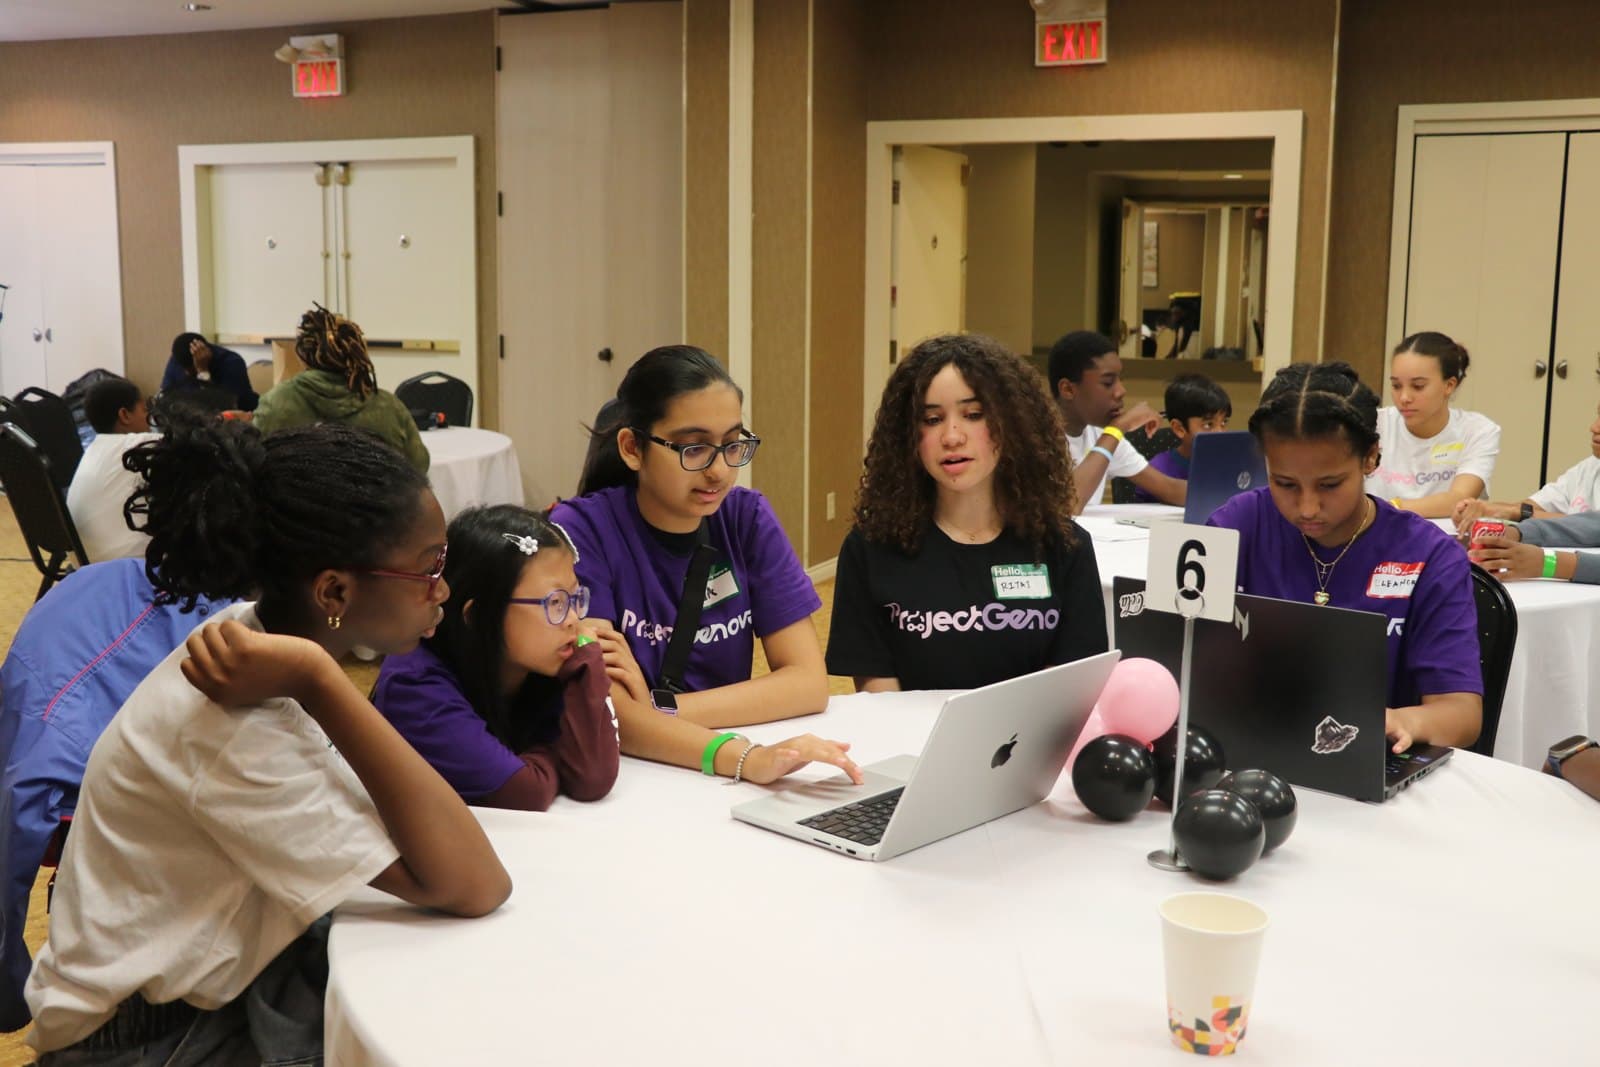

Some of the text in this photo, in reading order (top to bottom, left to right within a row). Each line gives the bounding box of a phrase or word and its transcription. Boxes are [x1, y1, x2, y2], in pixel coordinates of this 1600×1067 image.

[1043, 22, 1102, 61] EXIT
[298, 62, 337, 93] EXIT
[1176, 539, 1206, 600] 6
